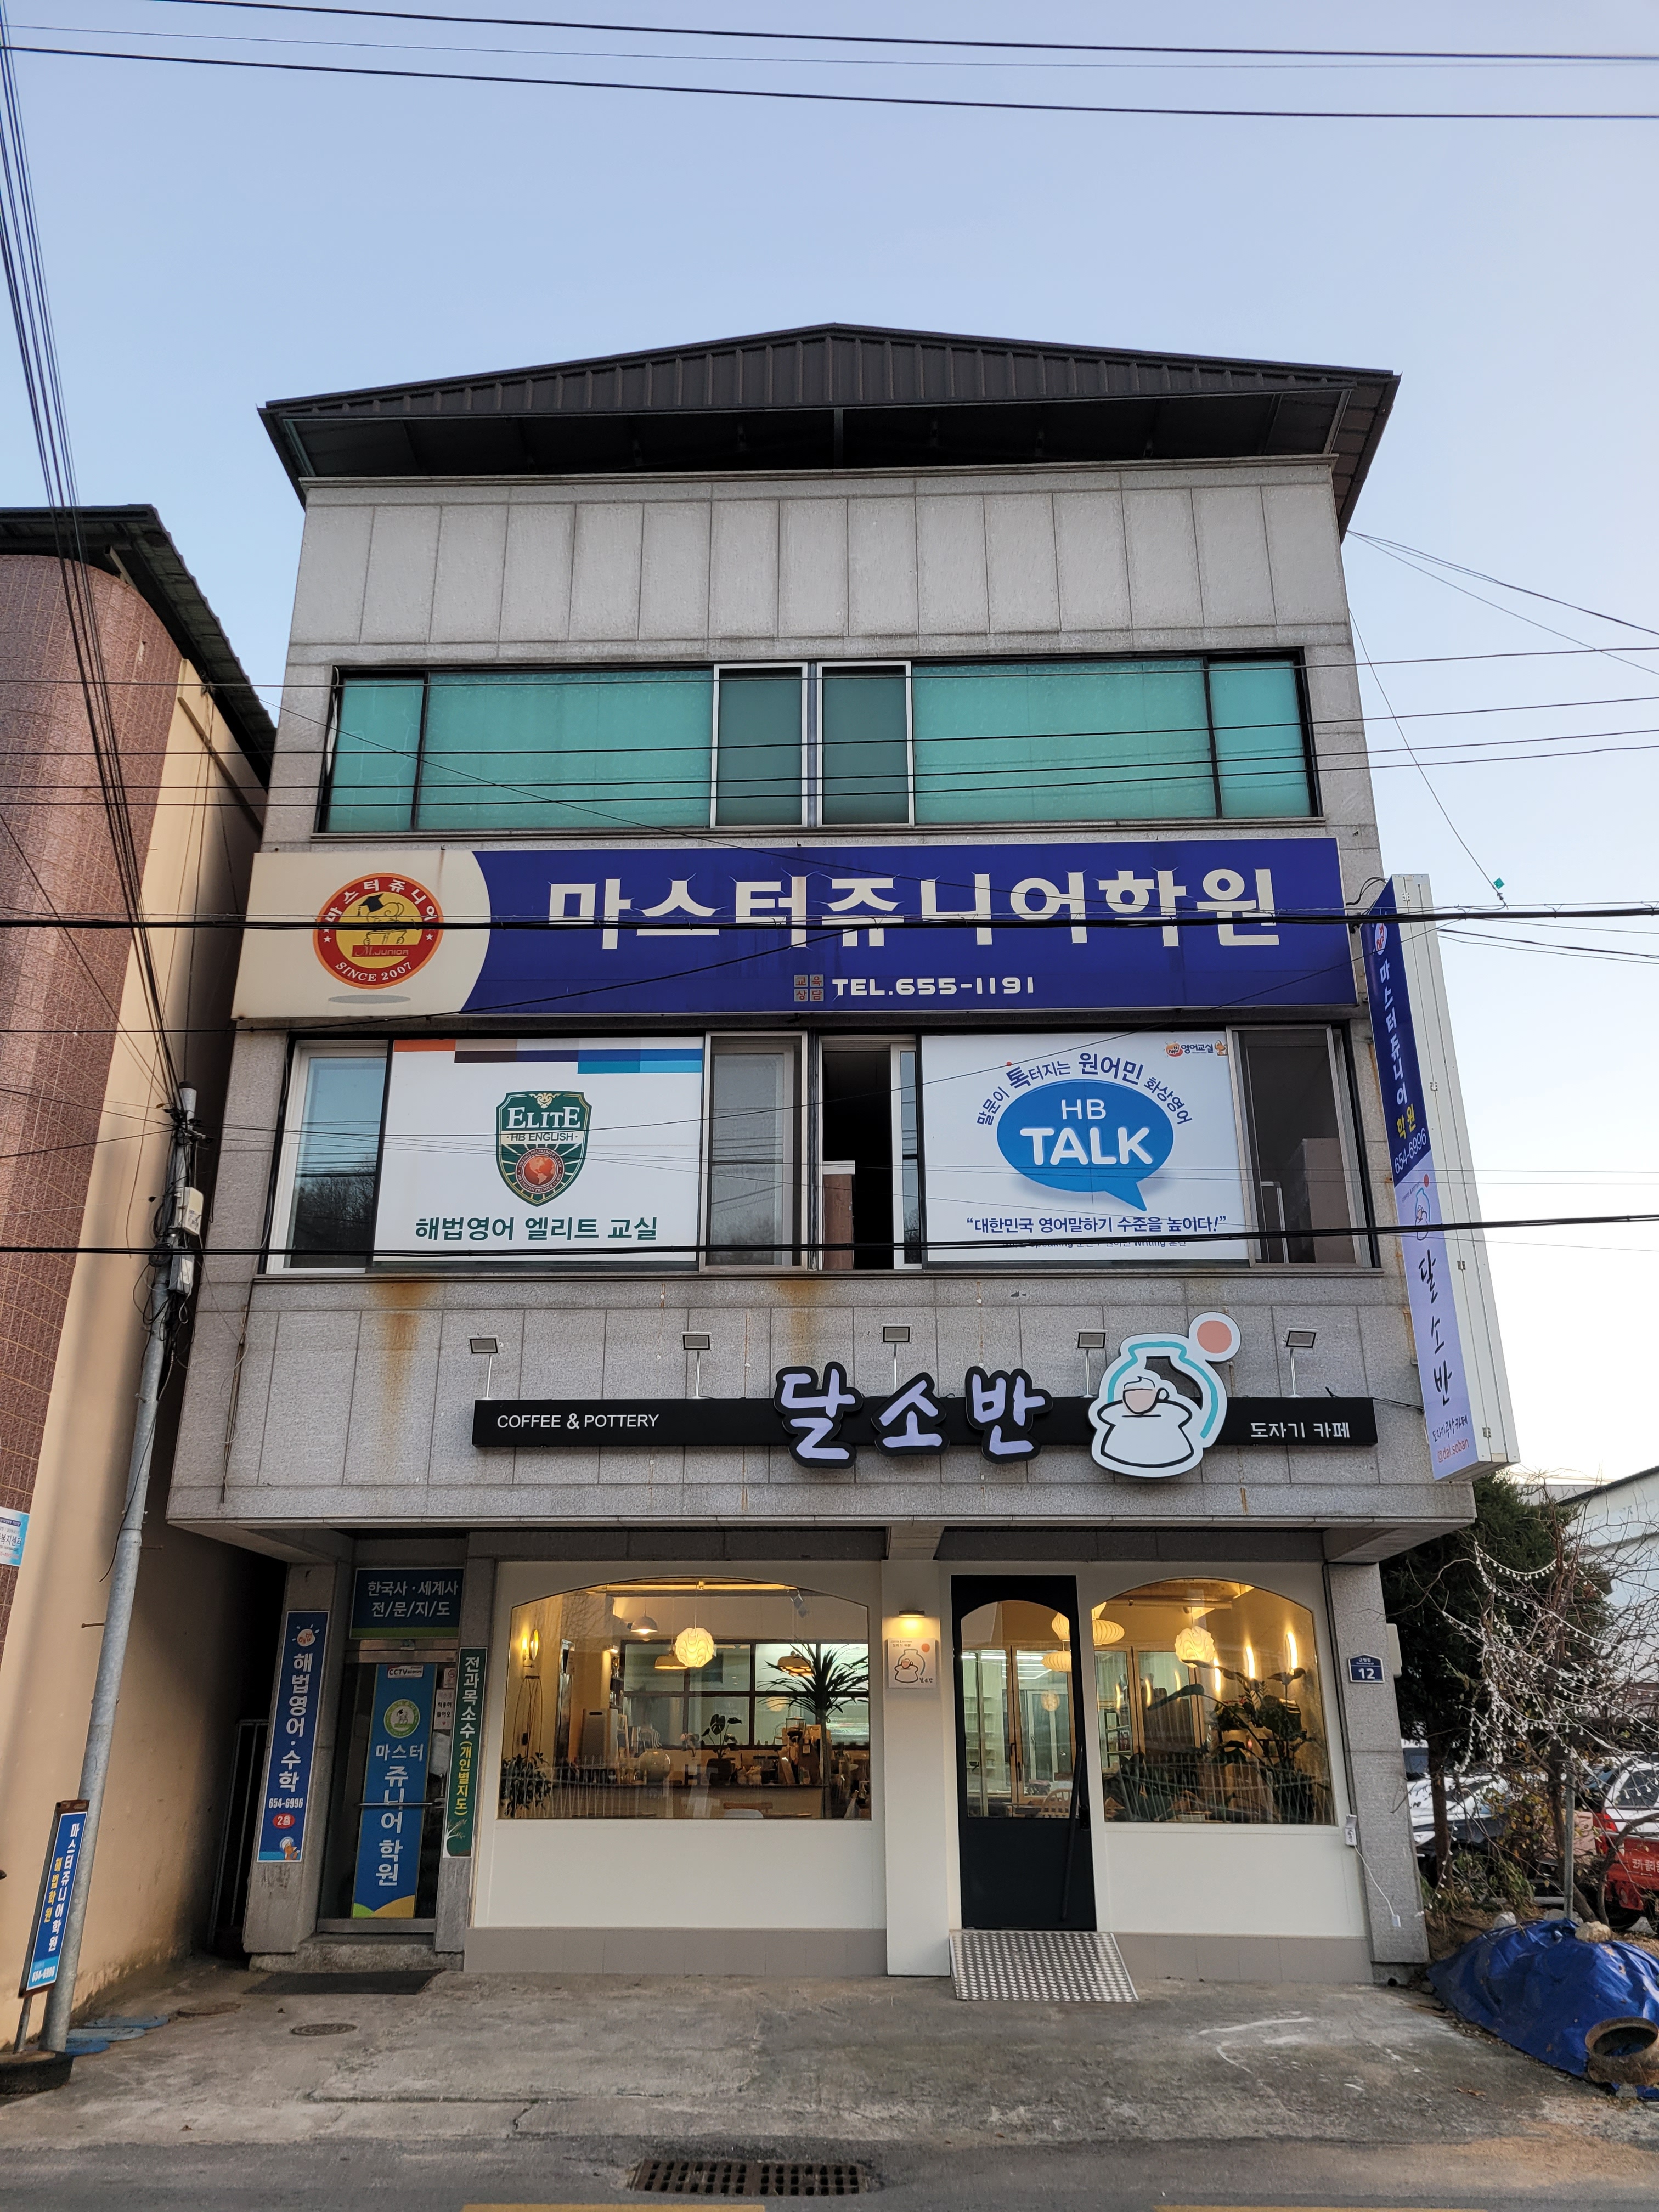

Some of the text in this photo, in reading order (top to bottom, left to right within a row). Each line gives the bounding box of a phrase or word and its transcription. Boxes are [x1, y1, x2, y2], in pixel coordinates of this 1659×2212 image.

[324, 879, 438, 922] 마스터쥬니어
[549, 868, 1279, 950] 마스터쥬니어학원
[335, 962, 412, 982] SINCE 2007
[796, 975, 822, 987] 교육
[796, 989, 823, 1001] 상담
[977, 1086, 1011, 1126] 말문이
[1079, 1052, 1144, 1085] 원어민
[1144, 1076, 1193, 1125] 화상영어
[1062, 1099, 1106, 1120] HB
[511, 1132, 574, 1142] HB ENGLISH
[1020, 1127, 1154, 1166] TALK
[1394, 1127, 1427, 1175] 654-6996
[415, 1217, 657, 1241] 해법영어 엘리트 교실
[1038, 1217, 1113, 1233] 영어말하기
[1116, 1217, 1163, 1233] 수준을
[1418, 1249, 1453, 1407] 달소반
[497, 1412, 659, 1430] COFFEE & POTTERY
[780, 1368, 1046, 1461] 달소반
[1250, 1421, 1351, 1439] 도자기 카페
[0, 1533, 22, 1547] 복지센터
[371, 1600, 451, 1618] 전/문/지/도
[1358, 1668, 1375, 1679] 12
[375, 1743, 424, 1762] 마스터
[268, 1798, 303, 1809] 654-6996
